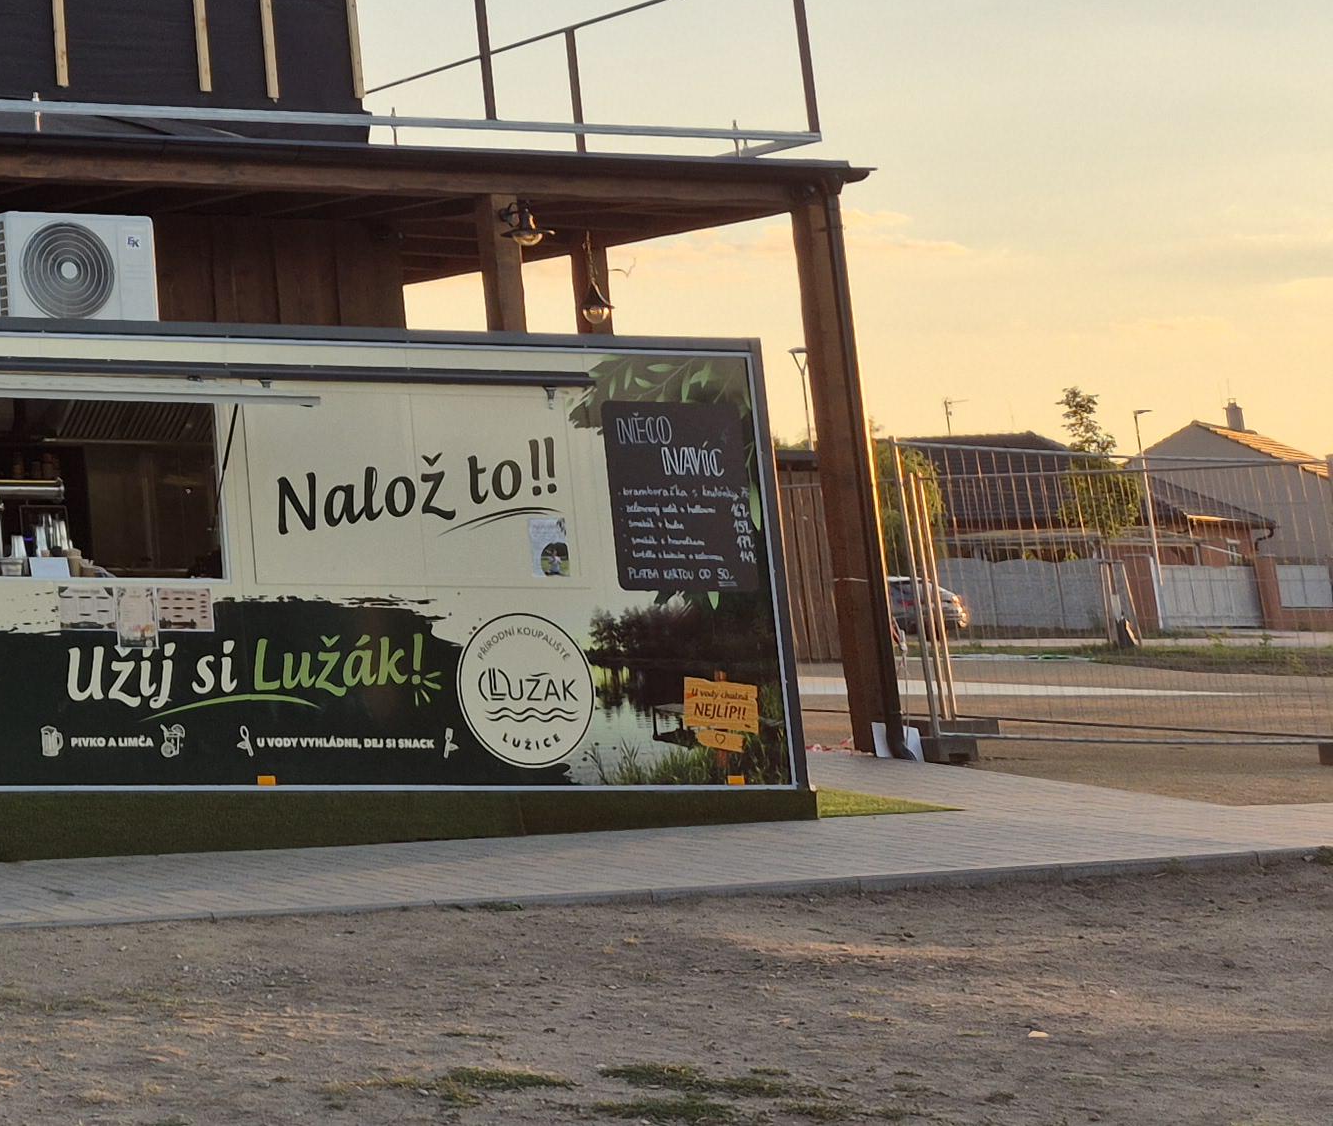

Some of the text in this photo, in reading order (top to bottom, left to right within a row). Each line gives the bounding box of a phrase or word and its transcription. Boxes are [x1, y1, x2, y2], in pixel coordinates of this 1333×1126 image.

[616, 412, 672, 445] NĚCO
[660, 440, 725, 477] NAVÍC
[276, 436, 558, 535] Nalož to!!
[477, 626, 516, 660] PŘÍRODNÍ
[67, 632, 424, 709] Užij si Lužák!
[700, 689, 719, 700] vody
[694, 701, 747, 720] NEJLÍP!!
[71, 734, 154, 747] PIVKO A LIMČA
[256, 735, 435, 749] U VODY VYHLÁDNE, DEJ SI SNACK
[502, 732, 561, 751] LUŽICE
